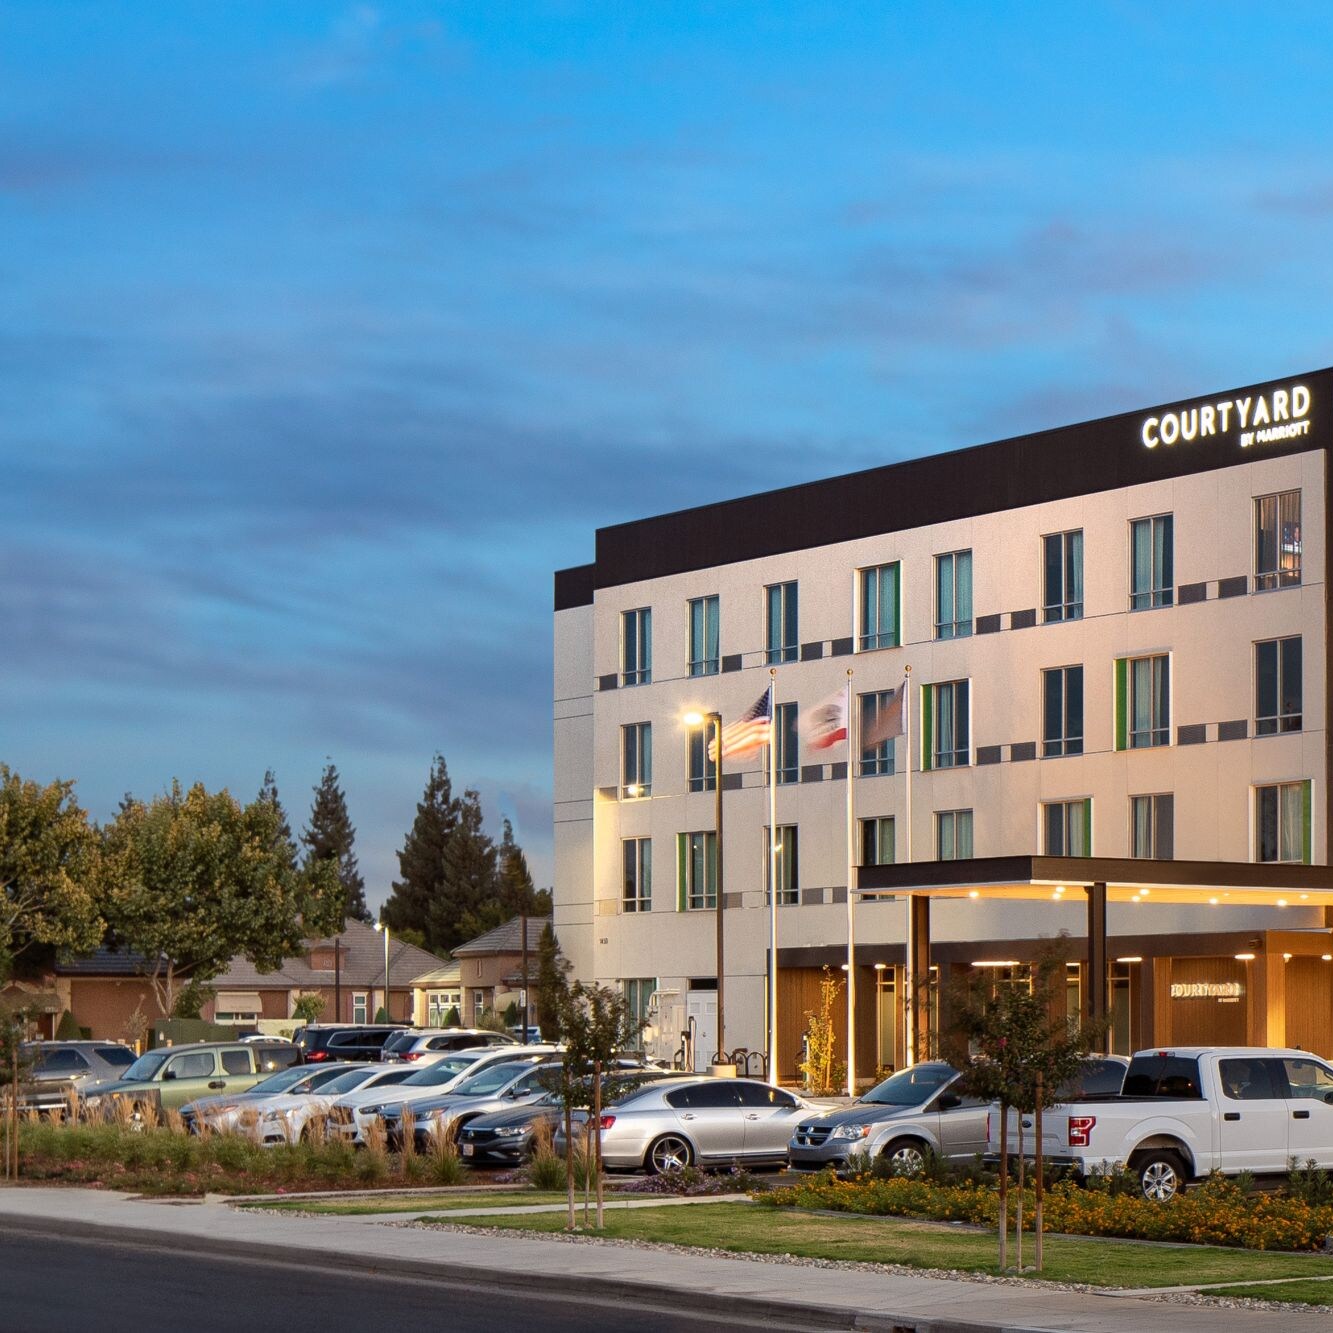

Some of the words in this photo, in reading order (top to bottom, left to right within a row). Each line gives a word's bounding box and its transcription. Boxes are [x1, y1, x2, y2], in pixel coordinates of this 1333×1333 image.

[1142, 385, 1311, 448] COURTYARD
[1240, 432, 1255, 447] BY
[1256, 420, 1311, 443] MARRIOTT
